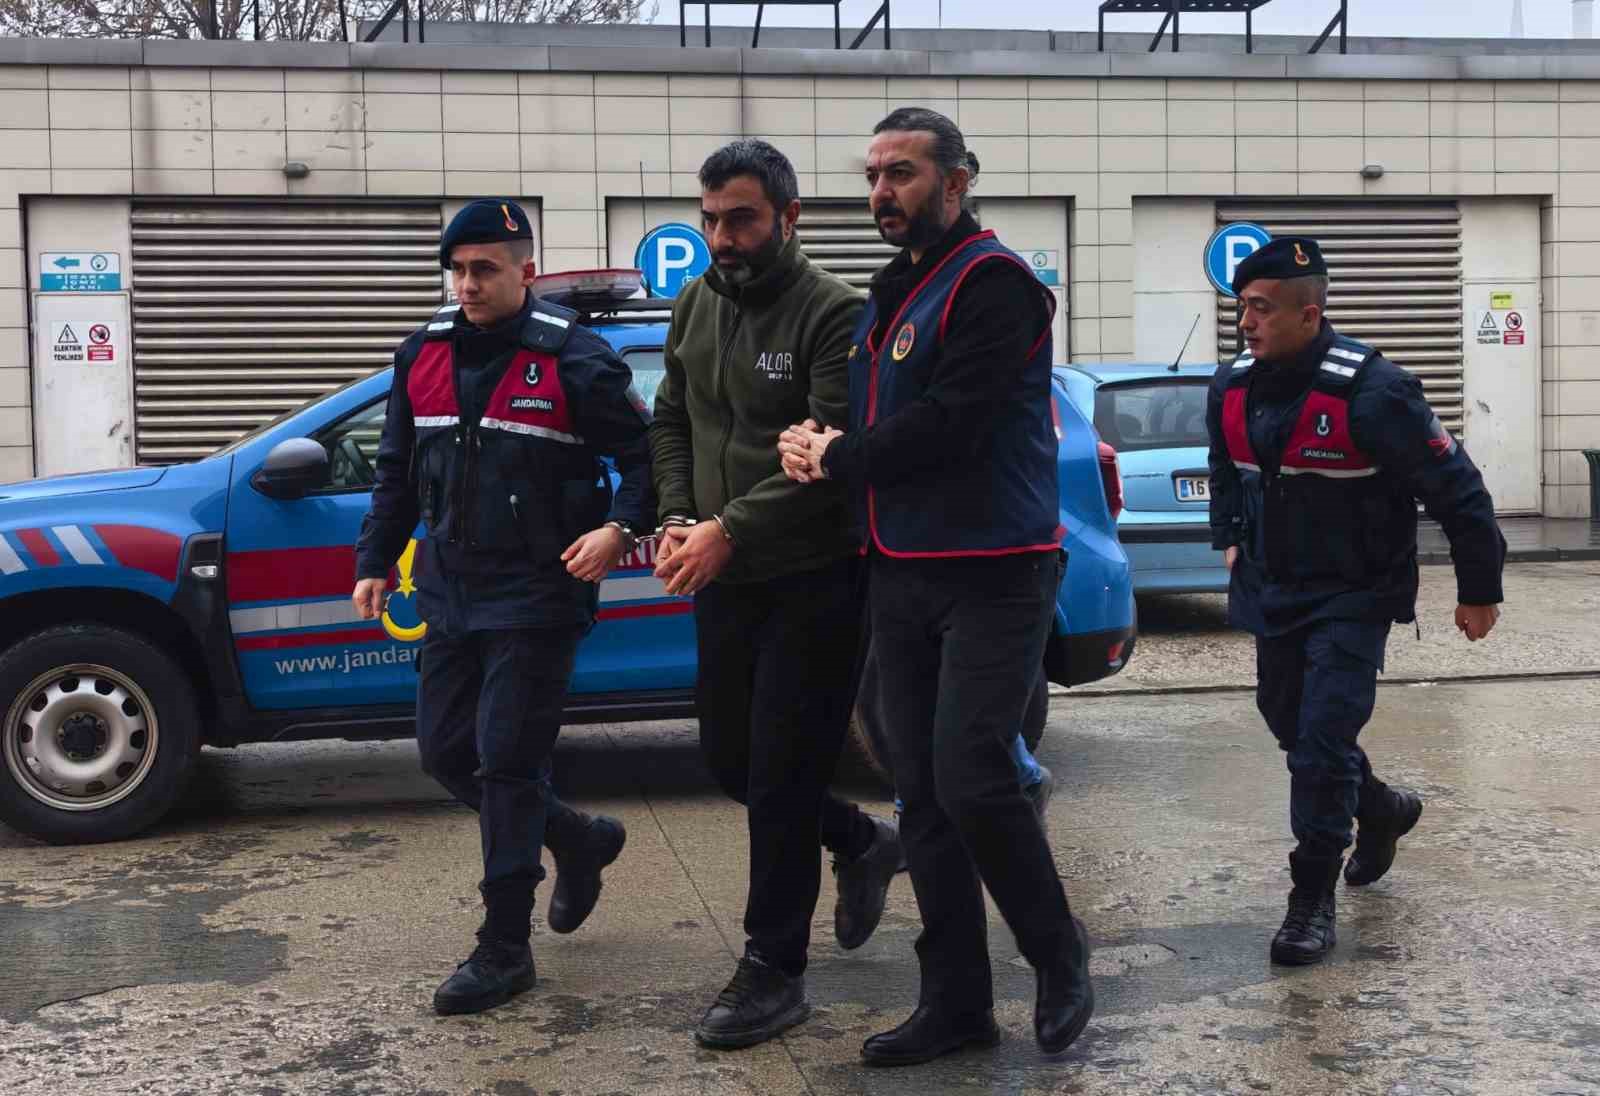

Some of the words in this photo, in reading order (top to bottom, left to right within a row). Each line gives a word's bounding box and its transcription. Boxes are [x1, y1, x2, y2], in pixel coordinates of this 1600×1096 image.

[657, 237, 695, 288] P
[1225, 235, 1260, 284] P
[511, 398, 553, 410] JANDARMA
[1189, 480, 1205, 496] 16
